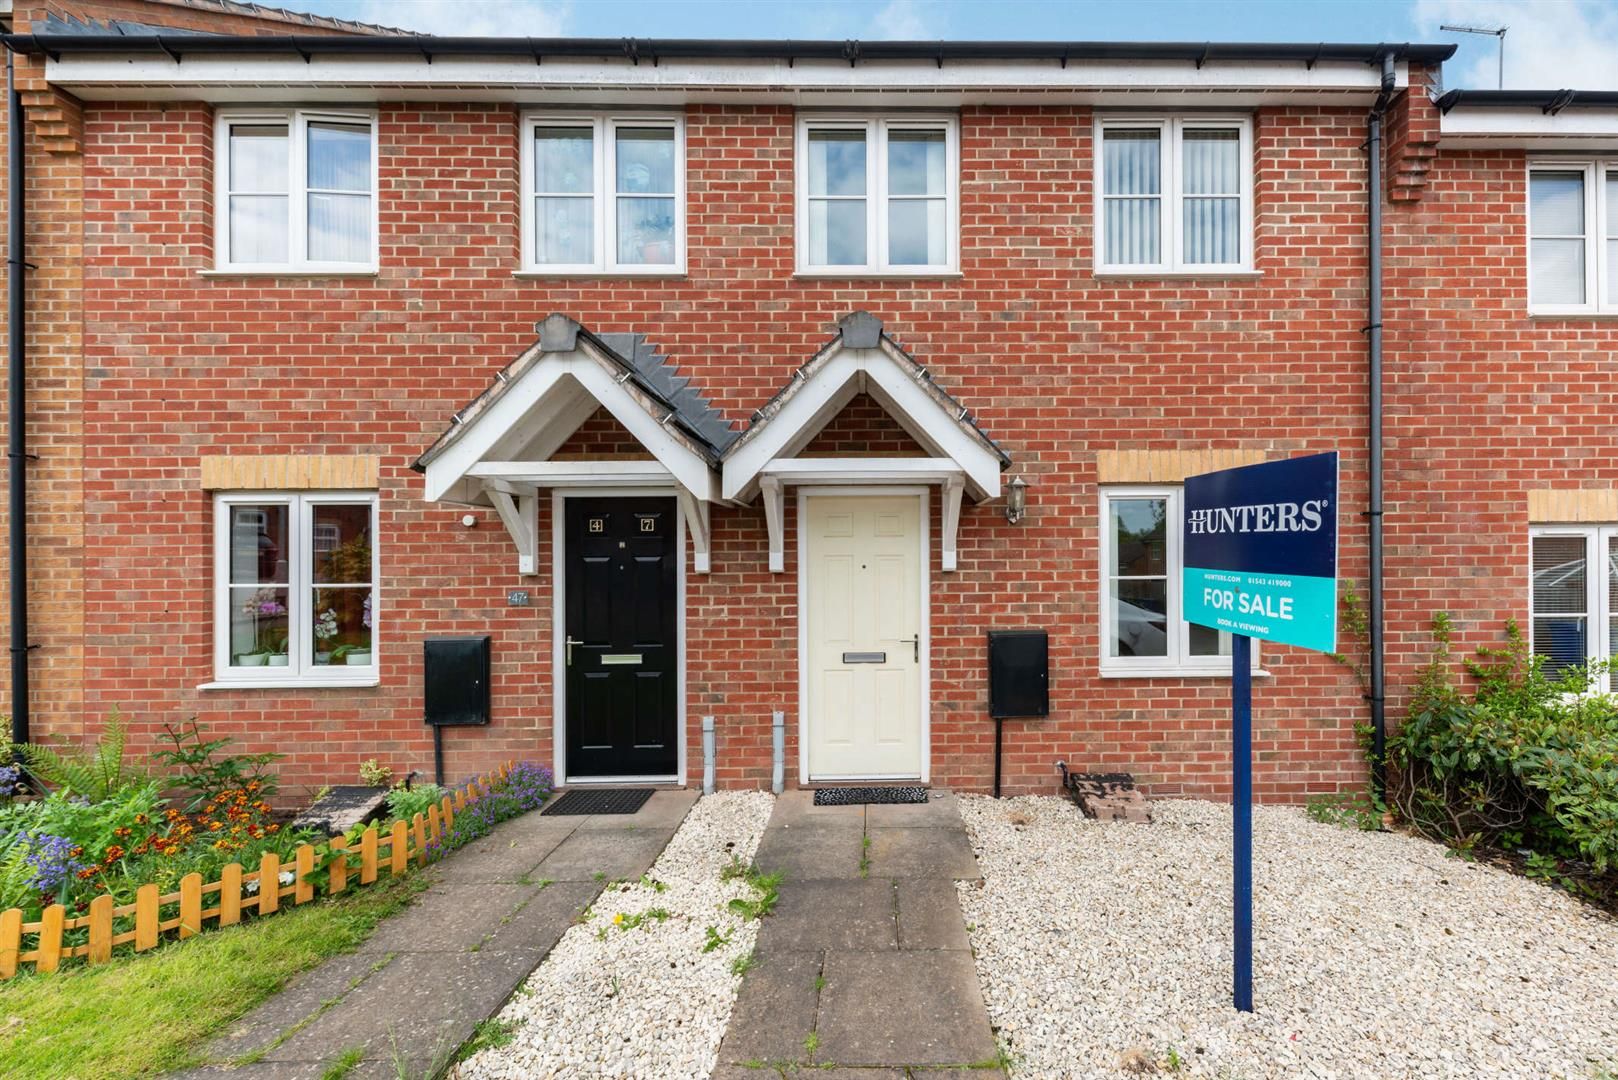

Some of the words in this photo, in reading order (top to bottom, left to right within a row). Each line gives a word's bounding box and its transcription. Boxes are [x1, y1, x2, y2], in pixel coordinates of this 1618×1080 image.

[592, 521, 601, 531] 4
[643, 520, 652, 530] 7
[1247, 577, 1266, 585] 01543
[511, 592, 525, 603] 47
[1204, 587, 1234, 611] FOR
[1238, 592, 1294, 620] SALE
[1217, 618, 1232, 627] BOOK
[1238, 622, 1269, 634] VIEWING
